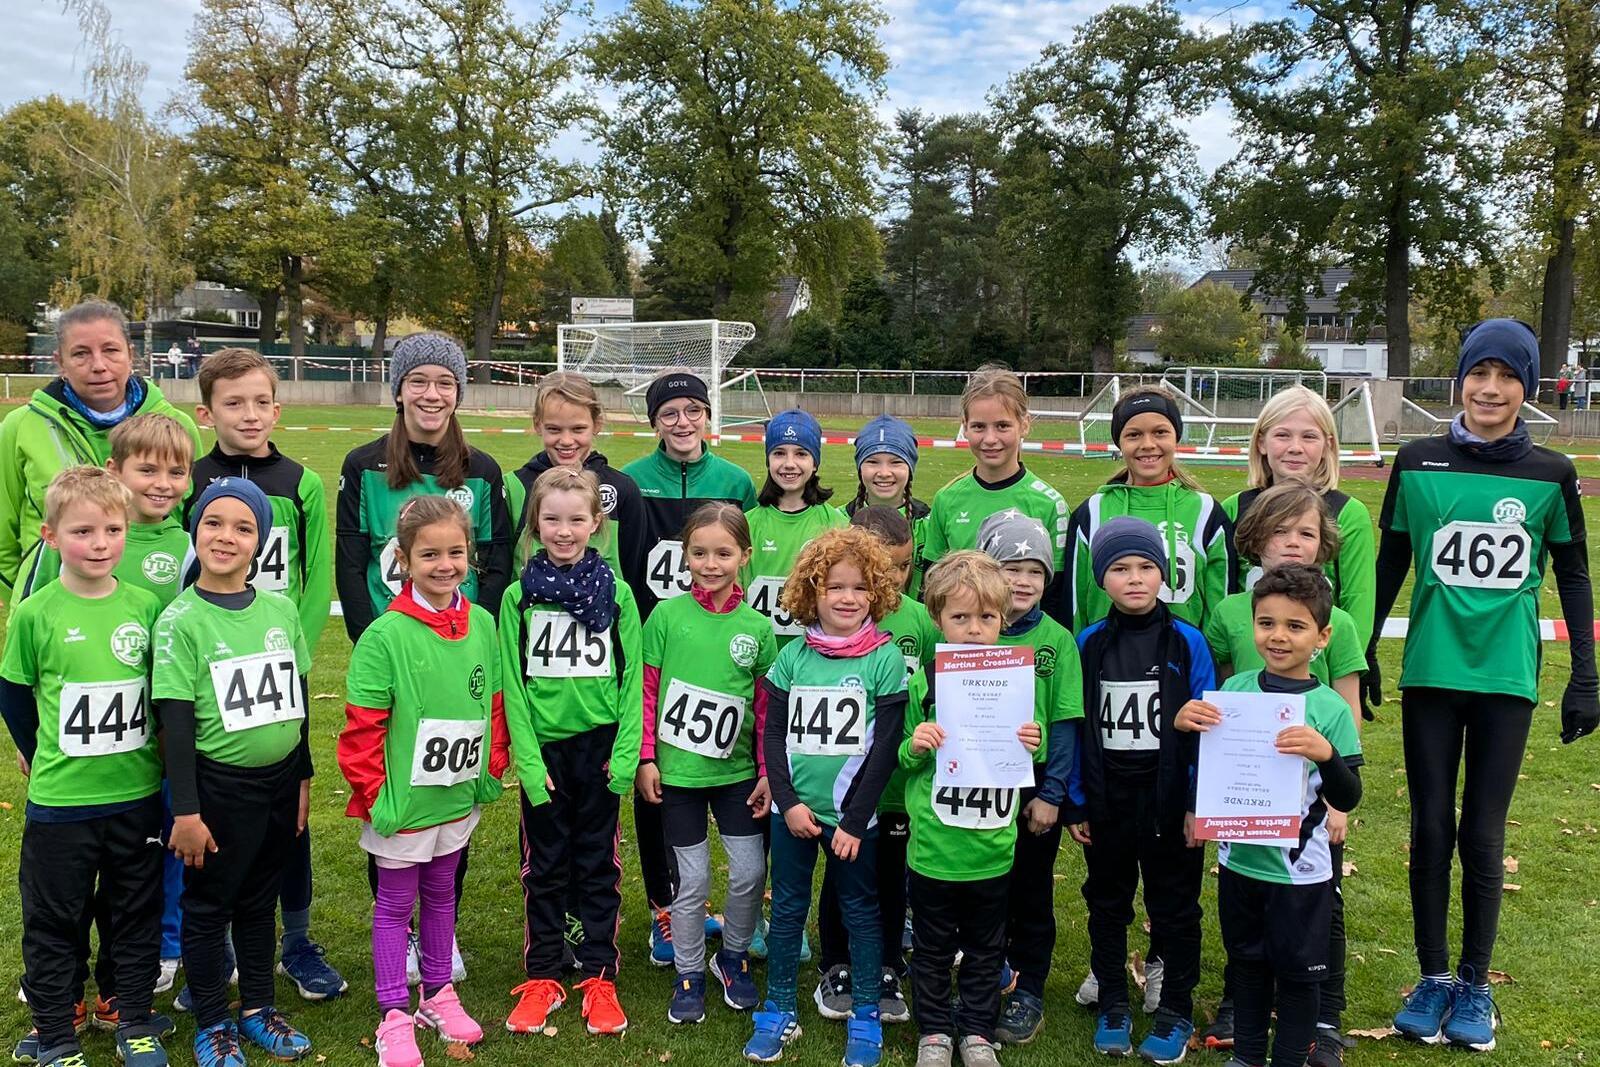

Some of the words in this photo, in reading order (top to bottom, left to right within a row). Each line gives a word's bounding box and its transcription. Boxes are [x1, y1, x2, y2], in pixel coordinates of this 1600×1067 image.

[668, 380, 688, 388] GORE
[1498, 507, 1523, 516] TUS
[1436, 531, 1525, 579] 462
[146, 559, 176, 573] TUS
[117, 637, 145, 651] TUS
[531, 621, 606, 667] 445
[734, 643, 756, 657] TUS
[985, 649, 1013, 658] Krefeld
[943, 661, 976, 669] Martins
[982, 656, 1025, 667] Crosslauf
[1035, 655, 1055, 668] TUS
[224, 661, 296, 717] 447
[962, 679, 1008, 687] URKUNDE
[64, 692, 147, 745] 444
[664, 693, 739, 750] 450
[790, 697, 860, 745] 442
[422, 735, 483, 773] 805
[935, 787, 1014, 819] 440
[1223, 796, 1271, 807] URKUNDE
[1204, 818, 1248, 828] Crosslauf
[1216, 830, 1246, 838] Krefeld
